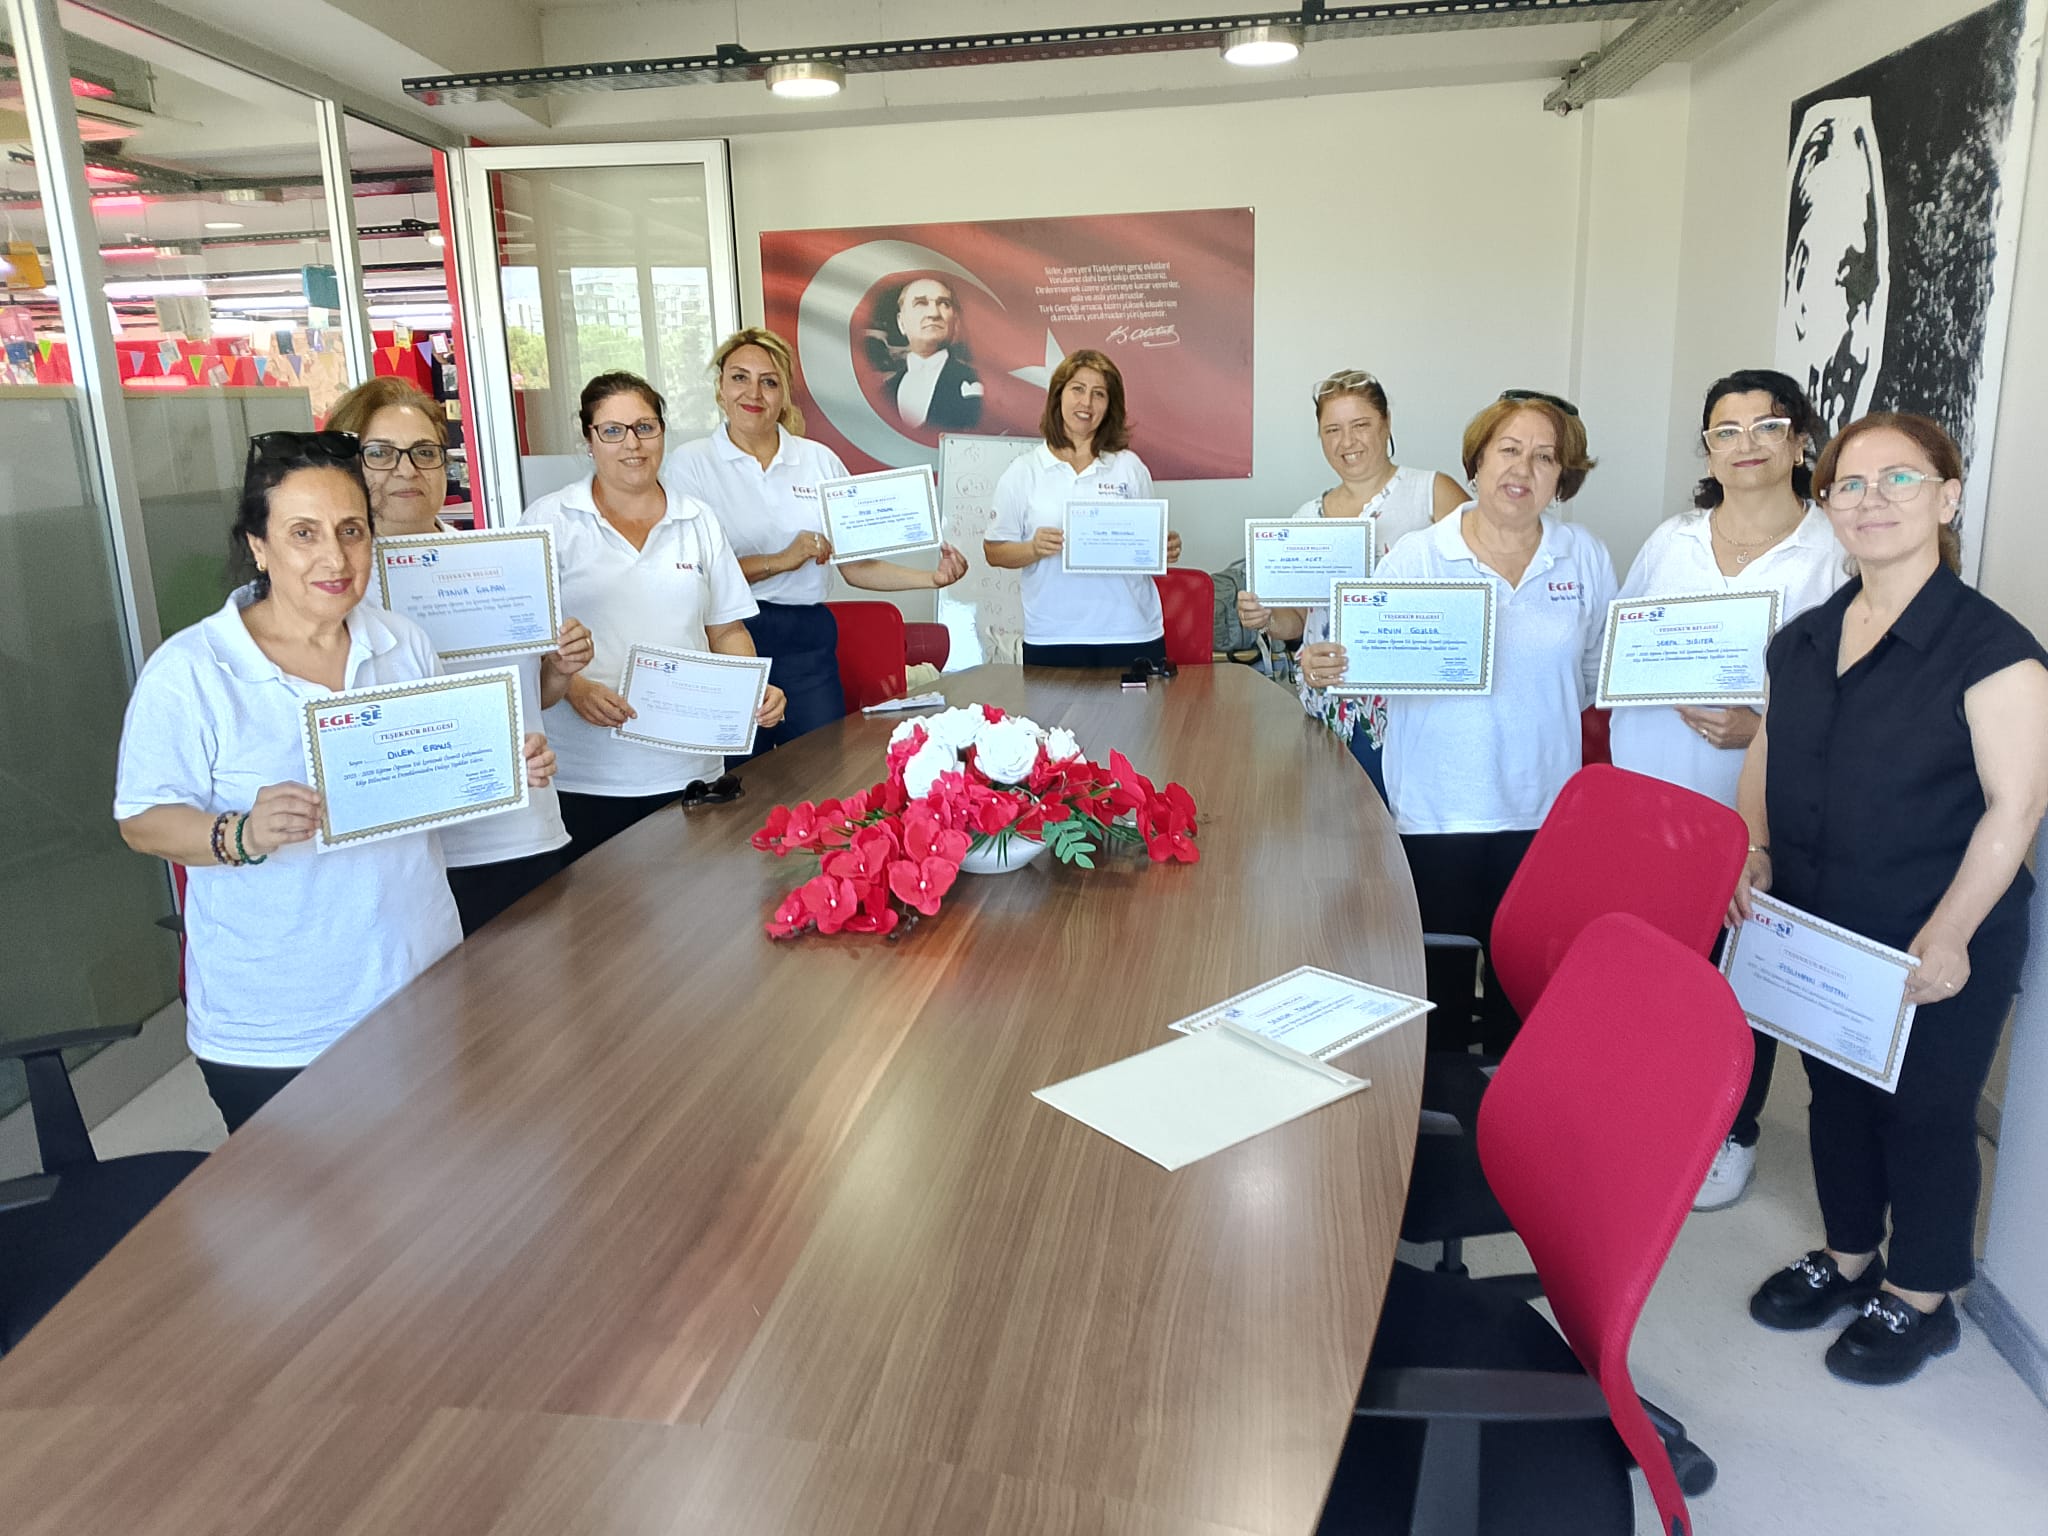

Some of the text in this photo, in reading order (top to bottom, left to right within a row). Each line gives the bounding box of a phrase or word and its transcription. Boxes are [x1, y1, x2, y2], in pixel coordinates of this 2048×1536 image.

[387, 553, 440, 566] EGE-SE
[1343, 594, 1388, 603] EGE-SE
[1619, 610, 1665, 621] EGE-SE
[636, 657, 680, 671] EGE-SE
[319, 708, 383, 729] EGE-SE
[1752, 911, 1792, 935] GE-SE
